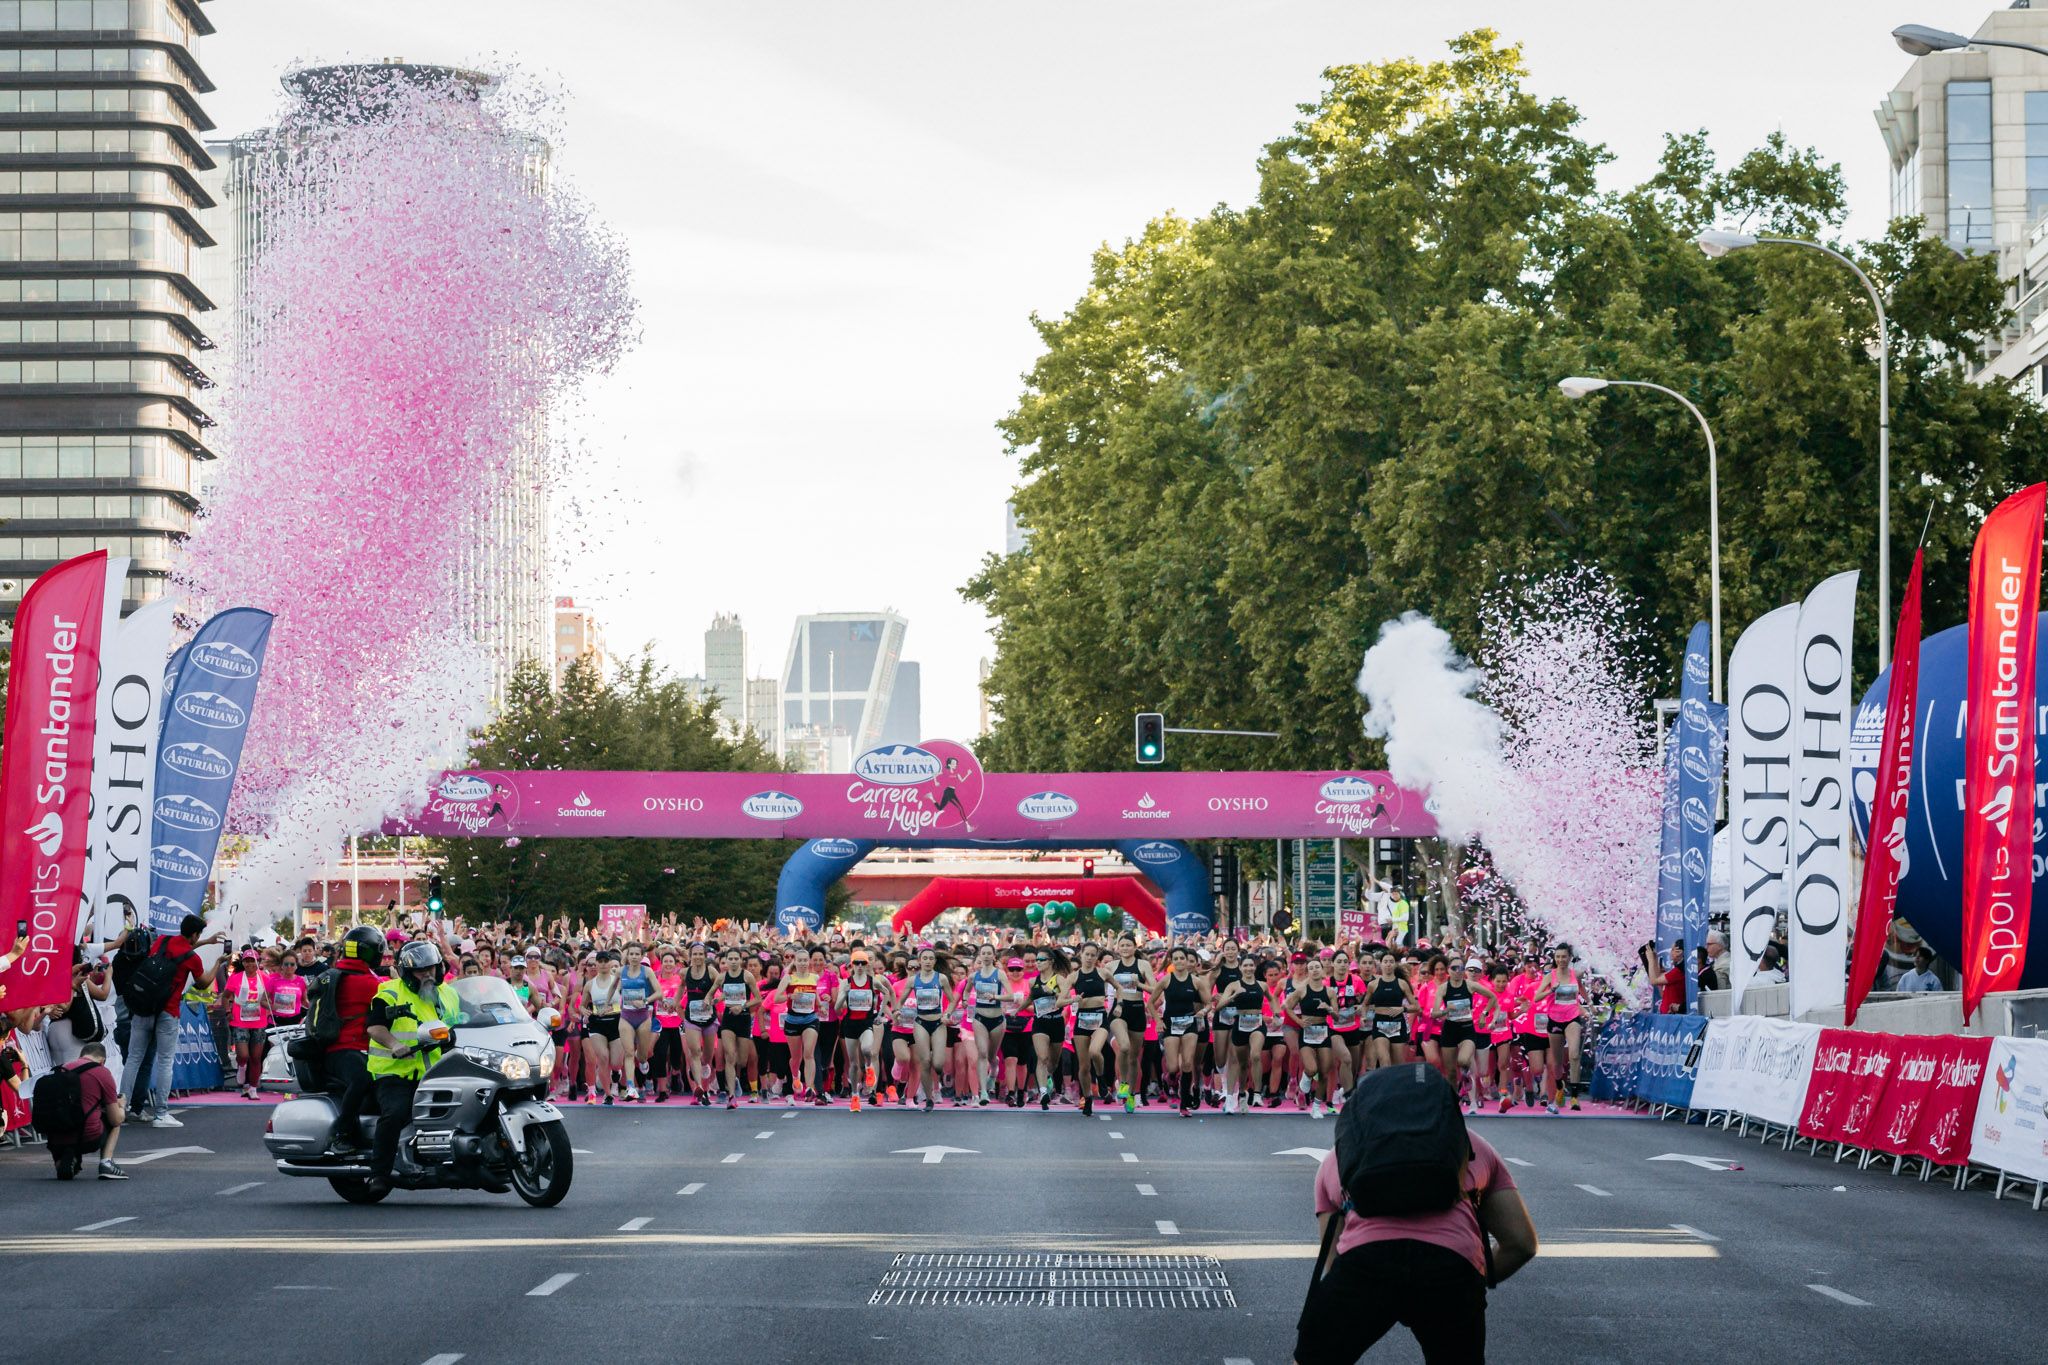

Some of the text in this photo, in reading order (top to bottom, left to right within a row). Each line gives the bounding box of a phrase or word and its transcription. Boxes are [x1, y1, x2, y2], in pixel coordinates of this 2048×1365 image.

[195, 650, 252, 674] ASTURIANA
[1987, 557, 2022, 778] Santander
[37, 615, 78, 805] Santander
[180, 699, 239, 724] ASTURIANA
[167, 750, 226, 775] ASTURIANA
[862, 759, 935, 774] ASTURIANA
[442, 785, 488, 795] ASTIANA
[847, 781, 919, 803] Carrera
[1324, 786, 1371, 796] ASTURIANA
[1795, 634, 1843, 936] OYSHO
[431, 799, 478, 812] Carrera
[643, 797, 704, 811] OYSHO
[747, 801, 798, 813] ASTURIANA
[1023, 802, 1073, 814] ASTURIANA
[1208, 797, 1268, 811] OYSHO
[1315, 800, 1360, 814] Carrera
[156, 802, 214, 828] ASTURIANA
[557, 807, 606, 817] Santander
[864, 800, 944, 836] de la Mujer
[1122, 809, 1171, 819] Santander
[458, 811, 494, 833] Mujer
[1341, 812, 1378, 834] Mujer
[1740, 683, 1791, 962] OYSHO
[815, 844, 854, 854] ASTURIANA
[1138, 849, 1178, 859] ASTURIANA
[1033, 887, 1075, 897] Santander
[22, 863, 61, 977] Sports
[781, 913, 818, 923] ASTUIANA
[1343, 912, 1364, 923] SUB
